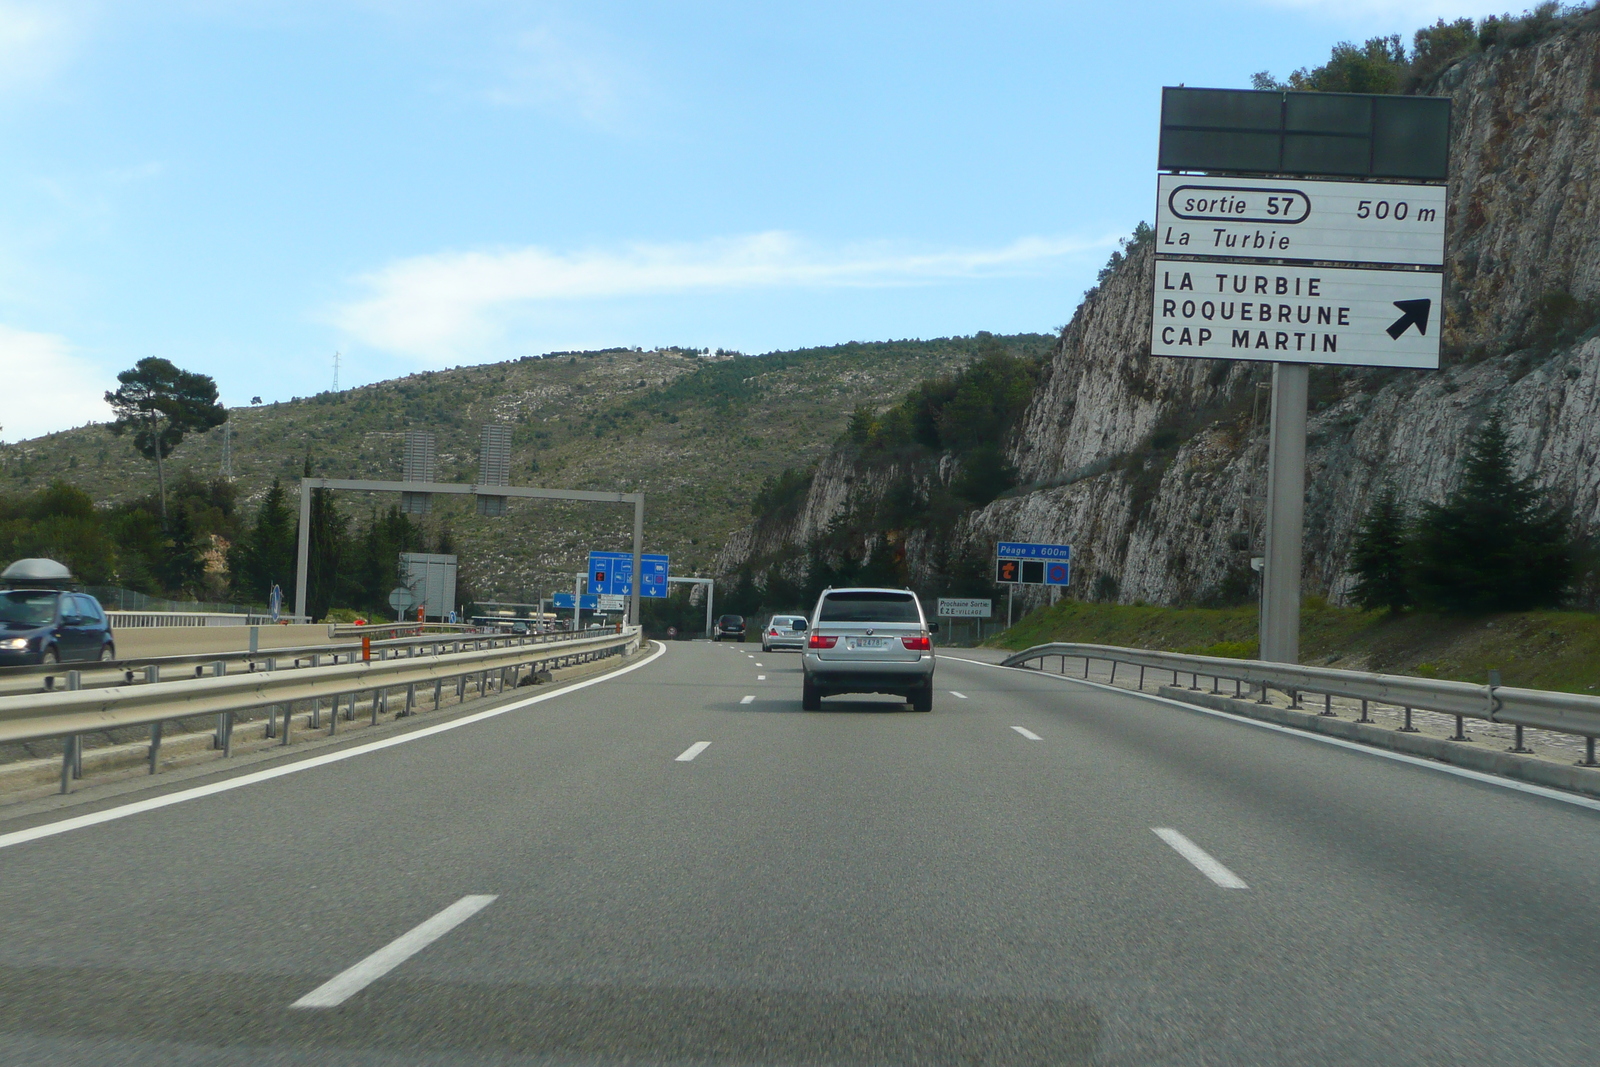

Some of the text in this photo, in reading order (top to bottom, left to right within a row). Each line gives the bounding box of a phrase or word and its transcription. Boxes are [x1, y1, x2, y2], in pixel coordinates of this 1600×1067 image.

[1184, 195, 1295, 216] sortie 57
[1357, 200, 1436, 222] 500 m
[1164, 226, 1291, 250] La Turbie
[1164, 271, 1321, 297] LA TURBIE
[1162, 299, 1350, 326] ROQUEBRUNE
[1161, 326, 1338, 353] CAP MARTIN
[1000, 545, 1027, 556] Péage
[1031, 546, 1036, 555] à
[940, 600, 969, 608] Prochaine
